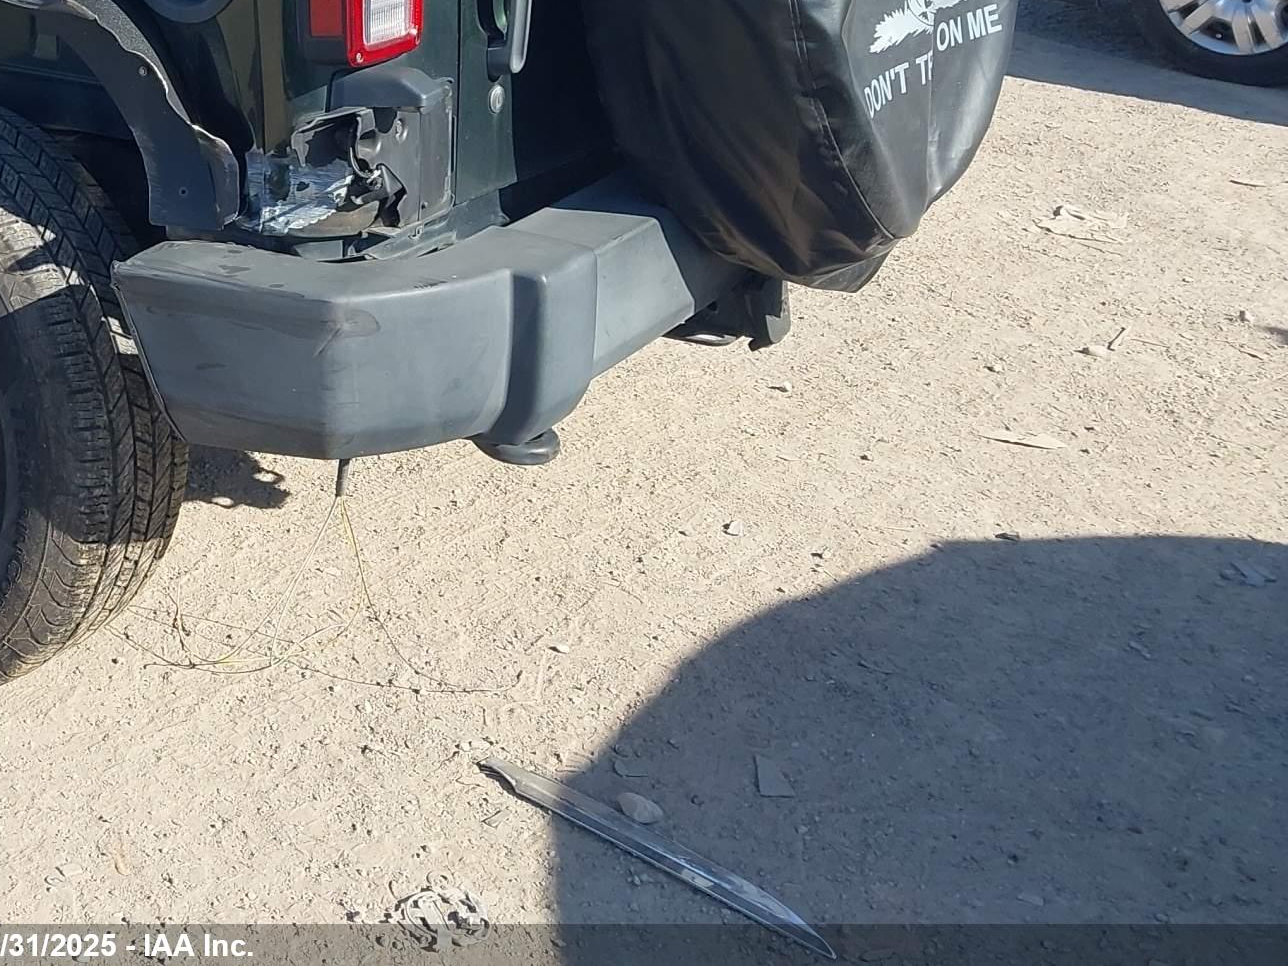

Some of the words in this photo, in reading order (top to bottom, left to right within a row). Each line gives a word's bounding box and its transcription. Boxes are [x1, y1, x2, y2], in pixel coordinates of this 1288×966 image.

[864, 62, 909, 119] DON'T
[936, 16, 963, 51] ON
[966, 4, 1002, 40] ME
